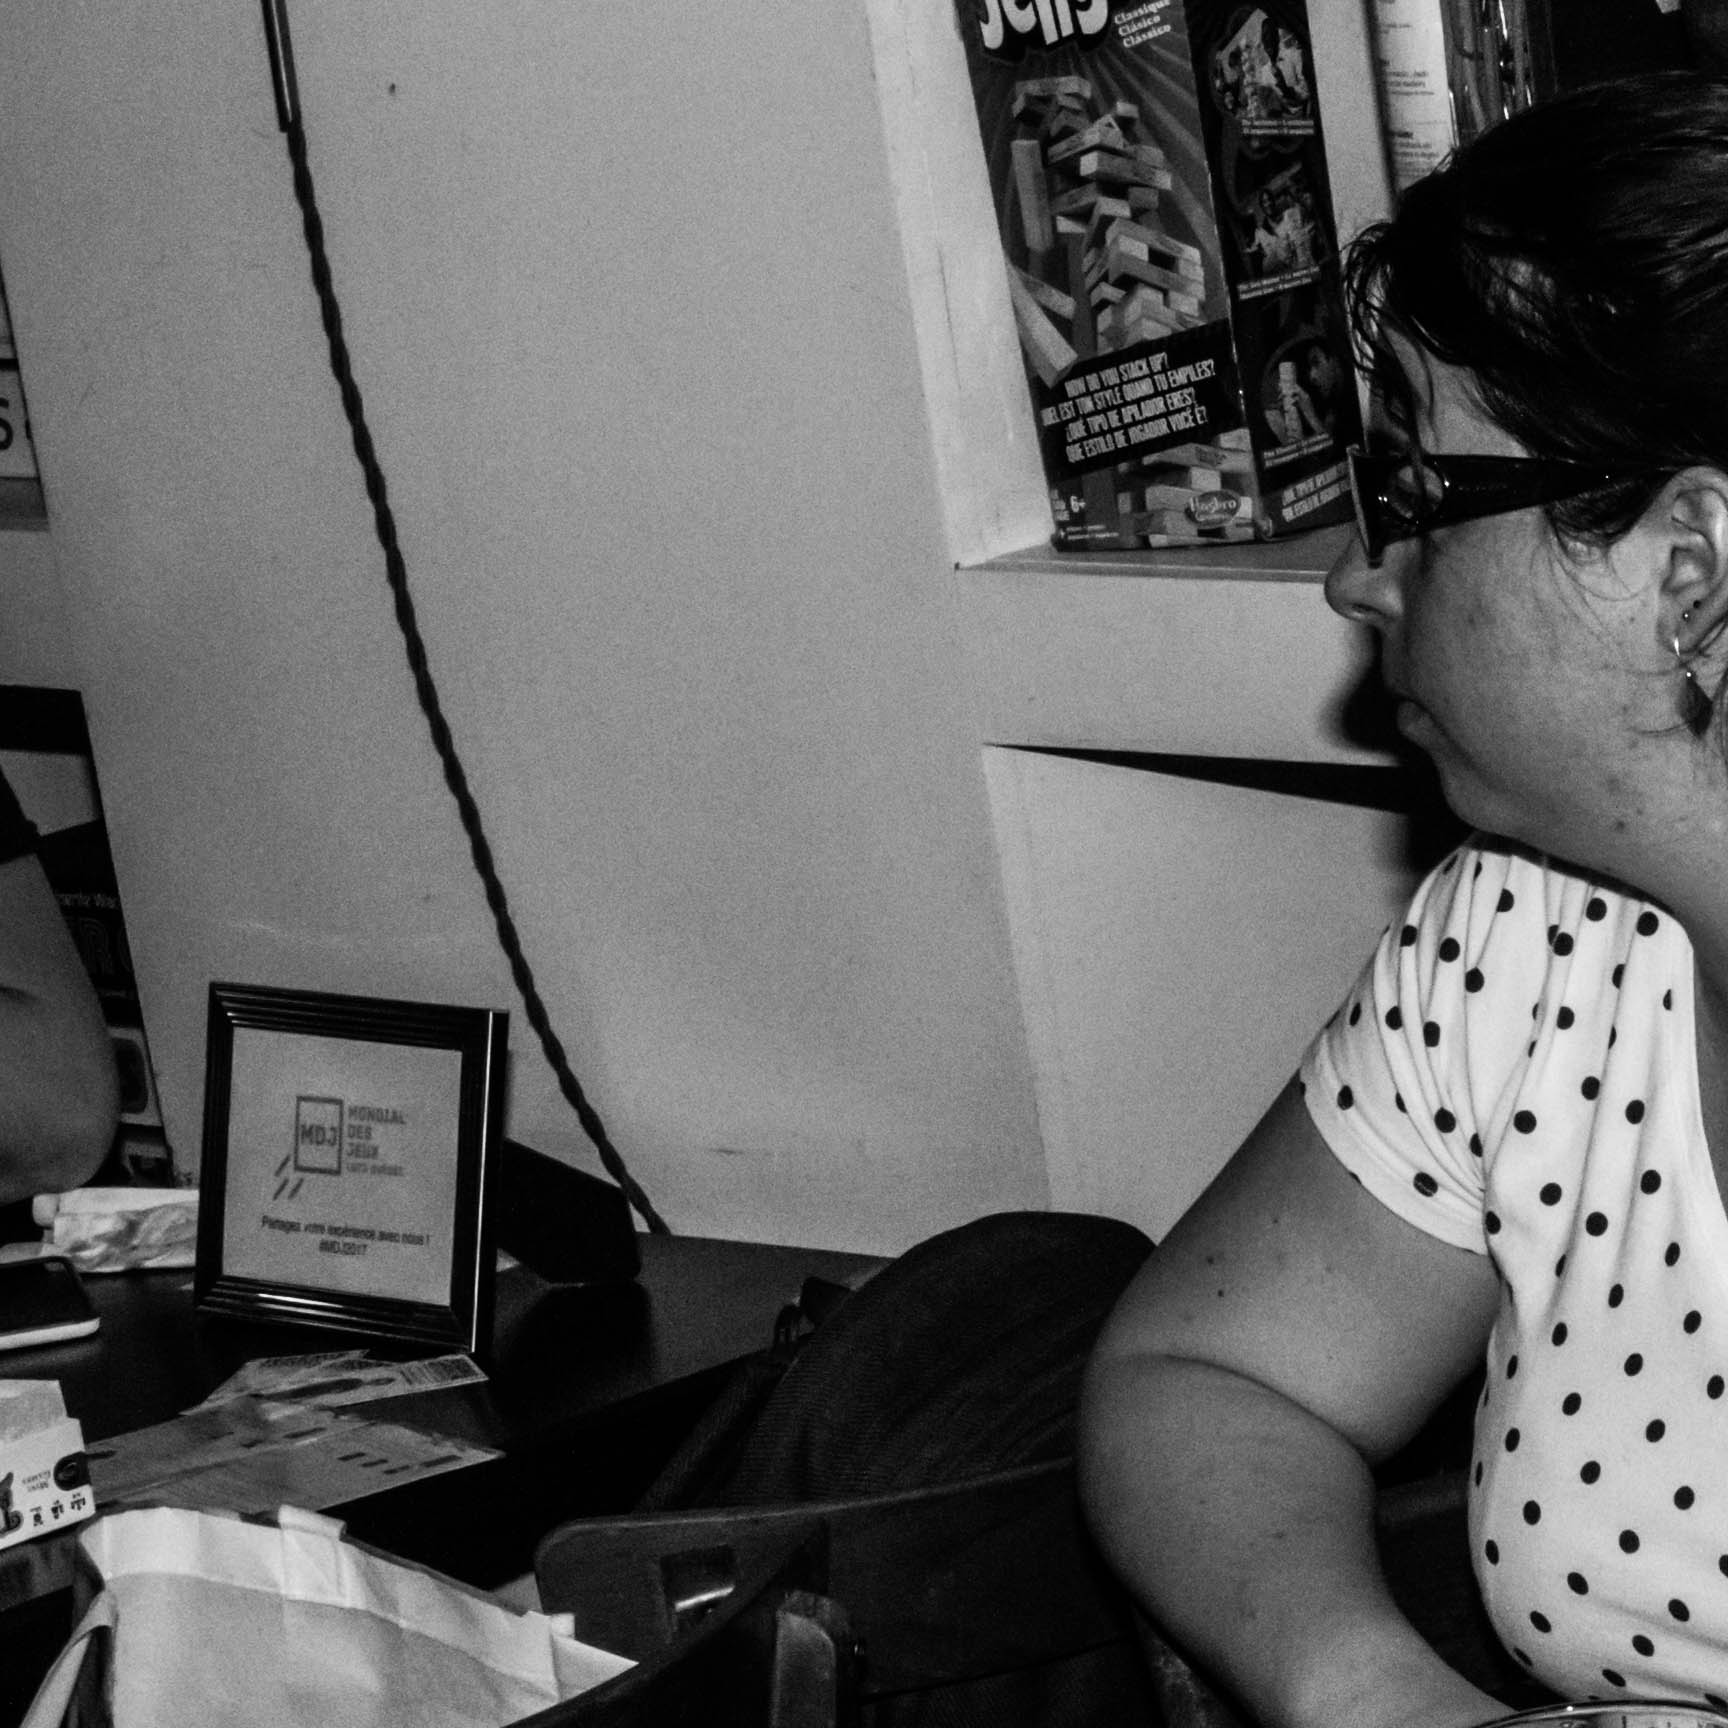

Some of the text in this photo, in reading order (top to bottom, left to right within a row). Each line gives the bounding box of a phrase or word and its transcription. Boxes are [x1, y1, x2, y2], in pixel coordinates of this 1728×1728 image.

[1119, 357, 1150, 382] STACK
[1093, 386, 1124, 410] STYLE
[1190, 495, 1237, 514] Hasbro
[300, 1123, 338, 1147] MDJ
[348, 1124, 372, 1140] DES
